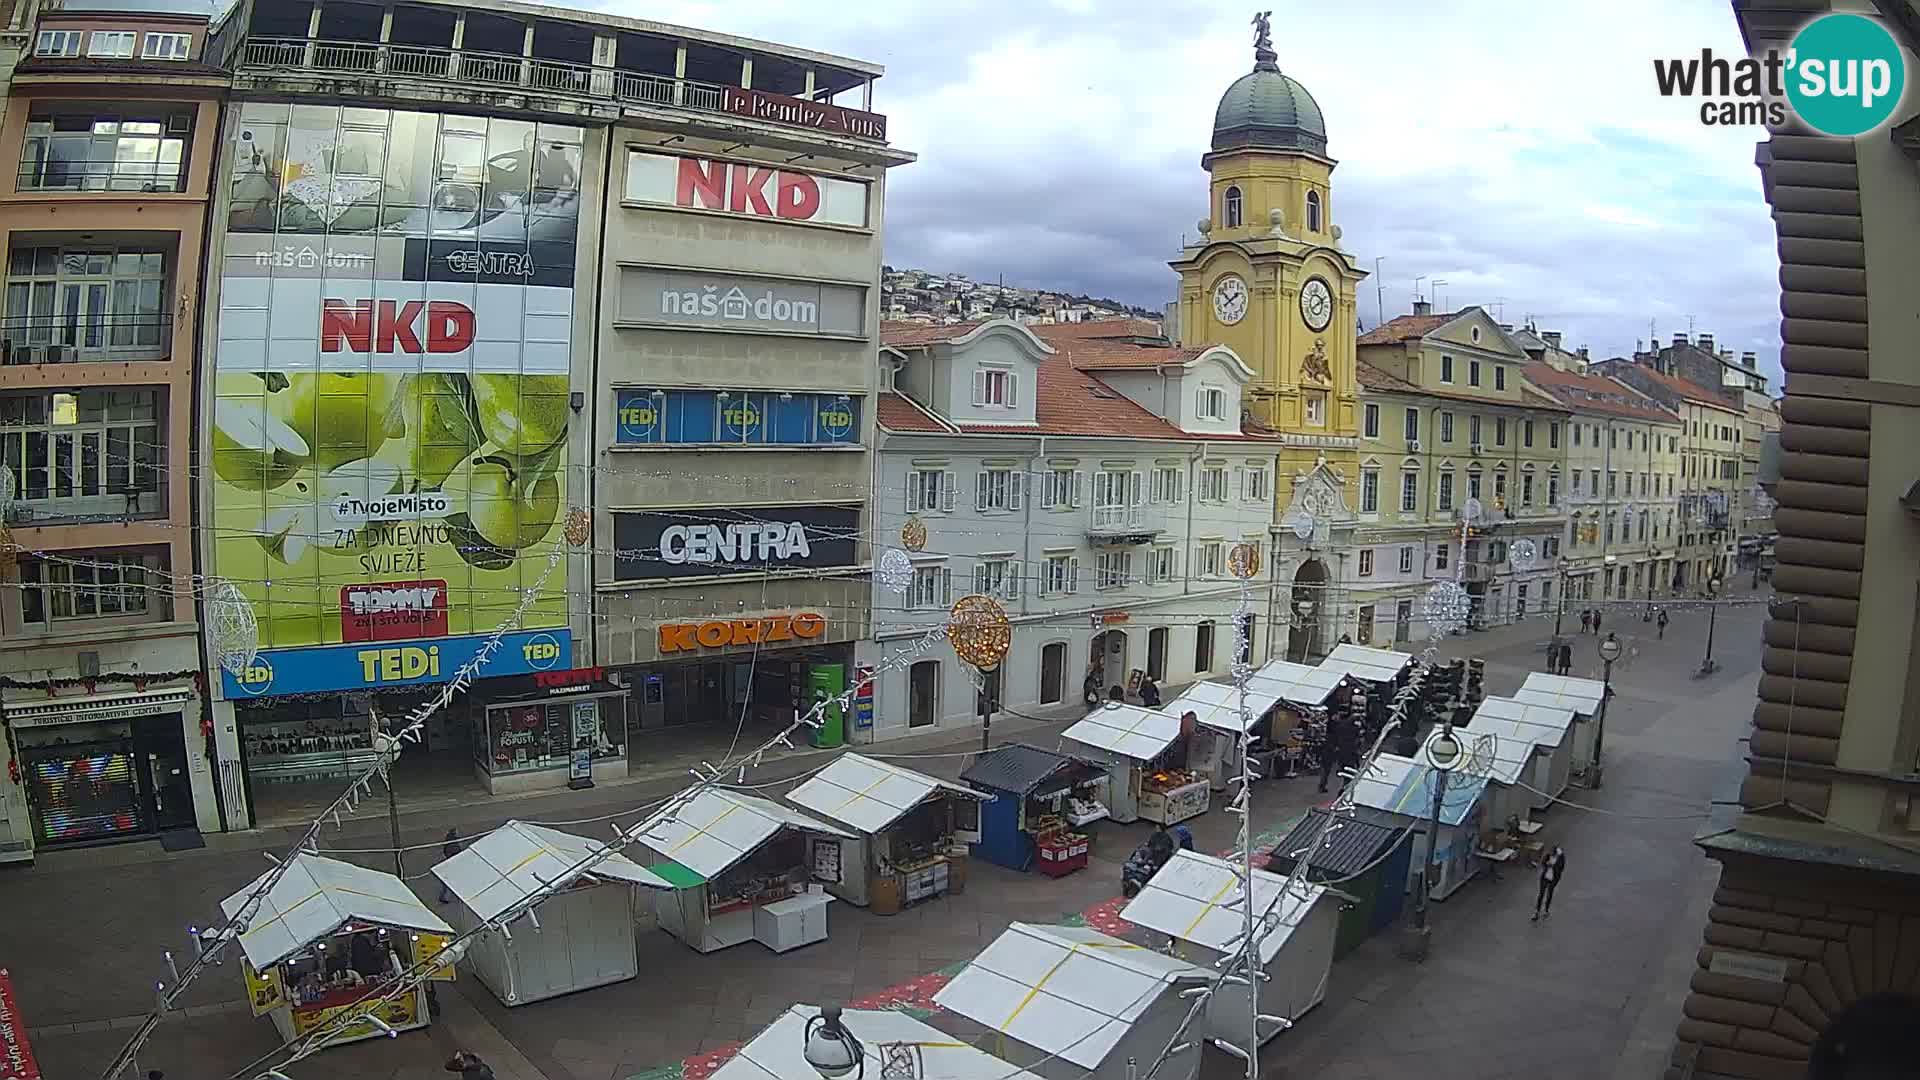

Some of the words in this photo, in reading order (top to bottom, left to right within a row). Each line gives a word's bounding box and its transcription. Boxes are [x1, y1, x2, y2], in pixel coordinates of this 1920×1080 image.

[723, 89, 745, 112] Le
[676, 159, 820, 220] NKD
[256, 247, 295, 267] naš
[320, 248, 367, 269] dom
[448, 250, 535, 276] CENTRA
[661, 285, 718, 316] naš
[755, 291, 816, 323] dom
[322, 298, 476, 353] NKD
[619, 409, 658, 425] TEDi
[724, 409, 760, 426] TEDi
[820, 411, 853, 427] TEDi
[338, 497, 446, 516] #TvojeMisto
[334, 528, 358, 549] ZA
[366, 524, 450, 547] DNEVNO
[659, 521, 811, 564] CENTRA
[359, 548, 427, 575] SVJEŽE
[349, 588, 437, 615] TOMMY
[660, 612, 826, 653] KORZO
[358, 646, 439, 682] TEDi
[523, 643, 560, 661] TEDi
